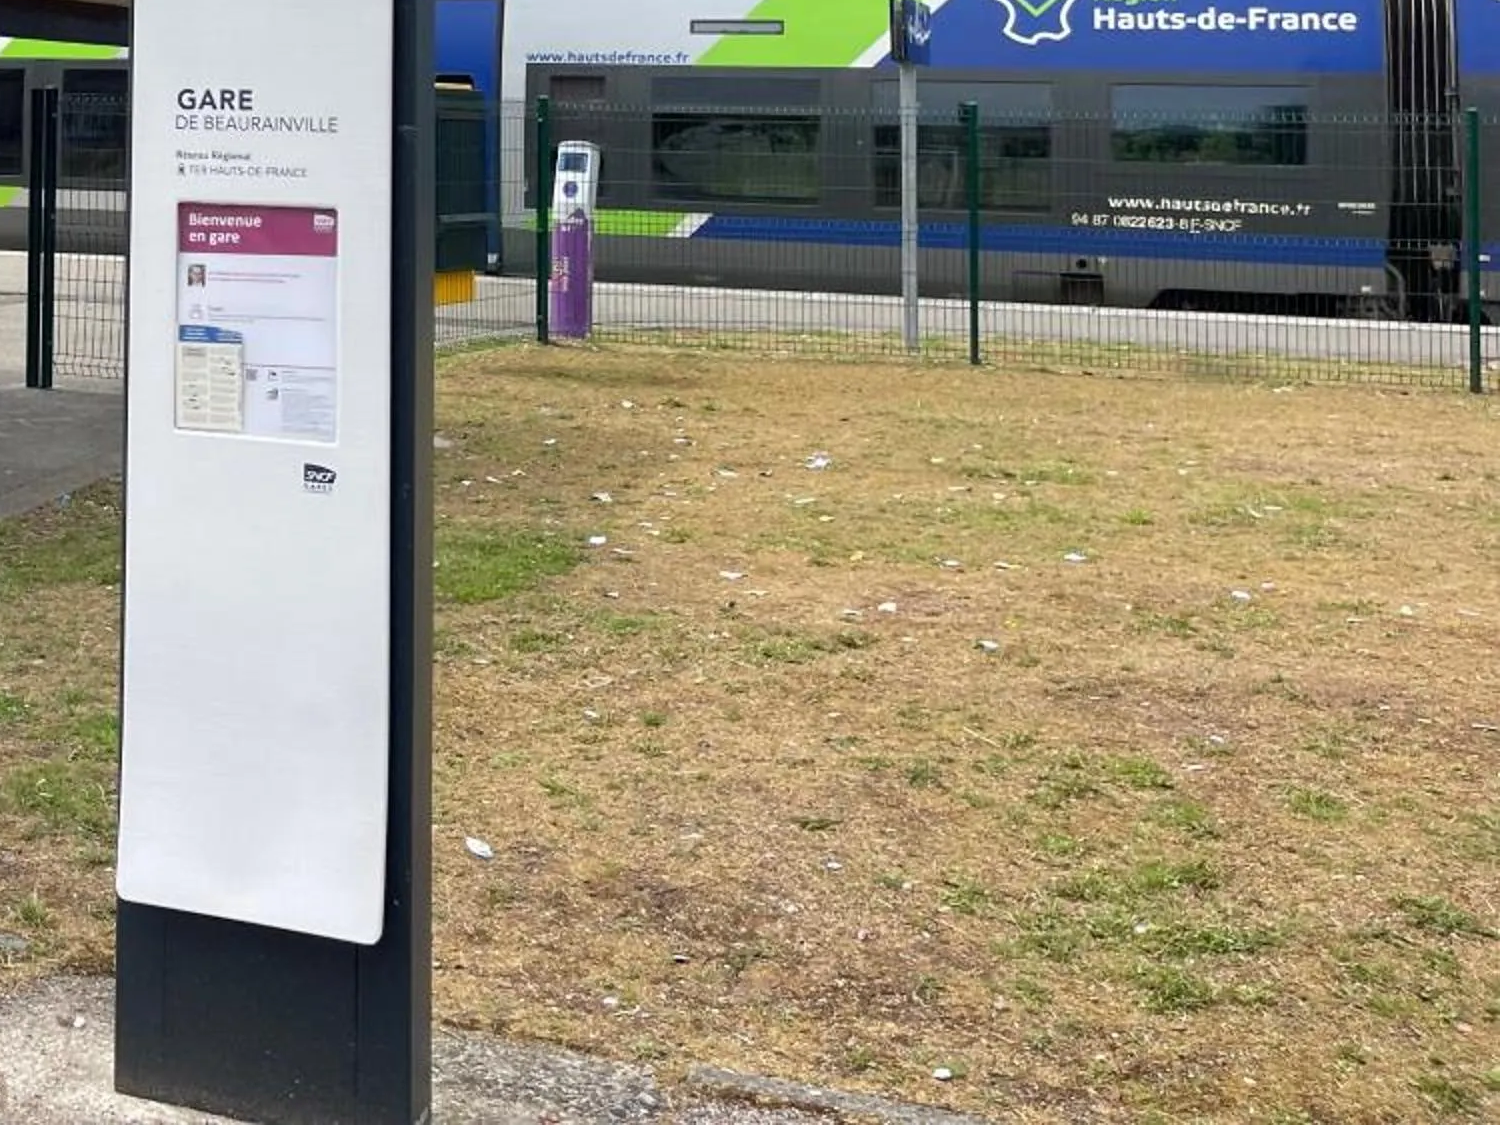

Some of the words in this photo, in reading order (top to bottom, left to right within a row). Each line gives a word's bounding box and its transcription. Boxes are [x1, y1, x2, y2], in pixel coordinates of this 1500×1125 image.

[1092, 7, 1358, 31] Hauts-de-France
[526, 51, 690, 64] www.hautsdefrance.fr
[177, 88, 253, 111] GARE
[175, 115, 199, 131] DE
[203, 115, 338, 133] BEAURAINVILLE
[189, 213, 263, 227] Bienvenue
[189, 232, 206, 242] en
[209, 233, 241, 245] gare
[304, 470, 334, 482] SNCF
